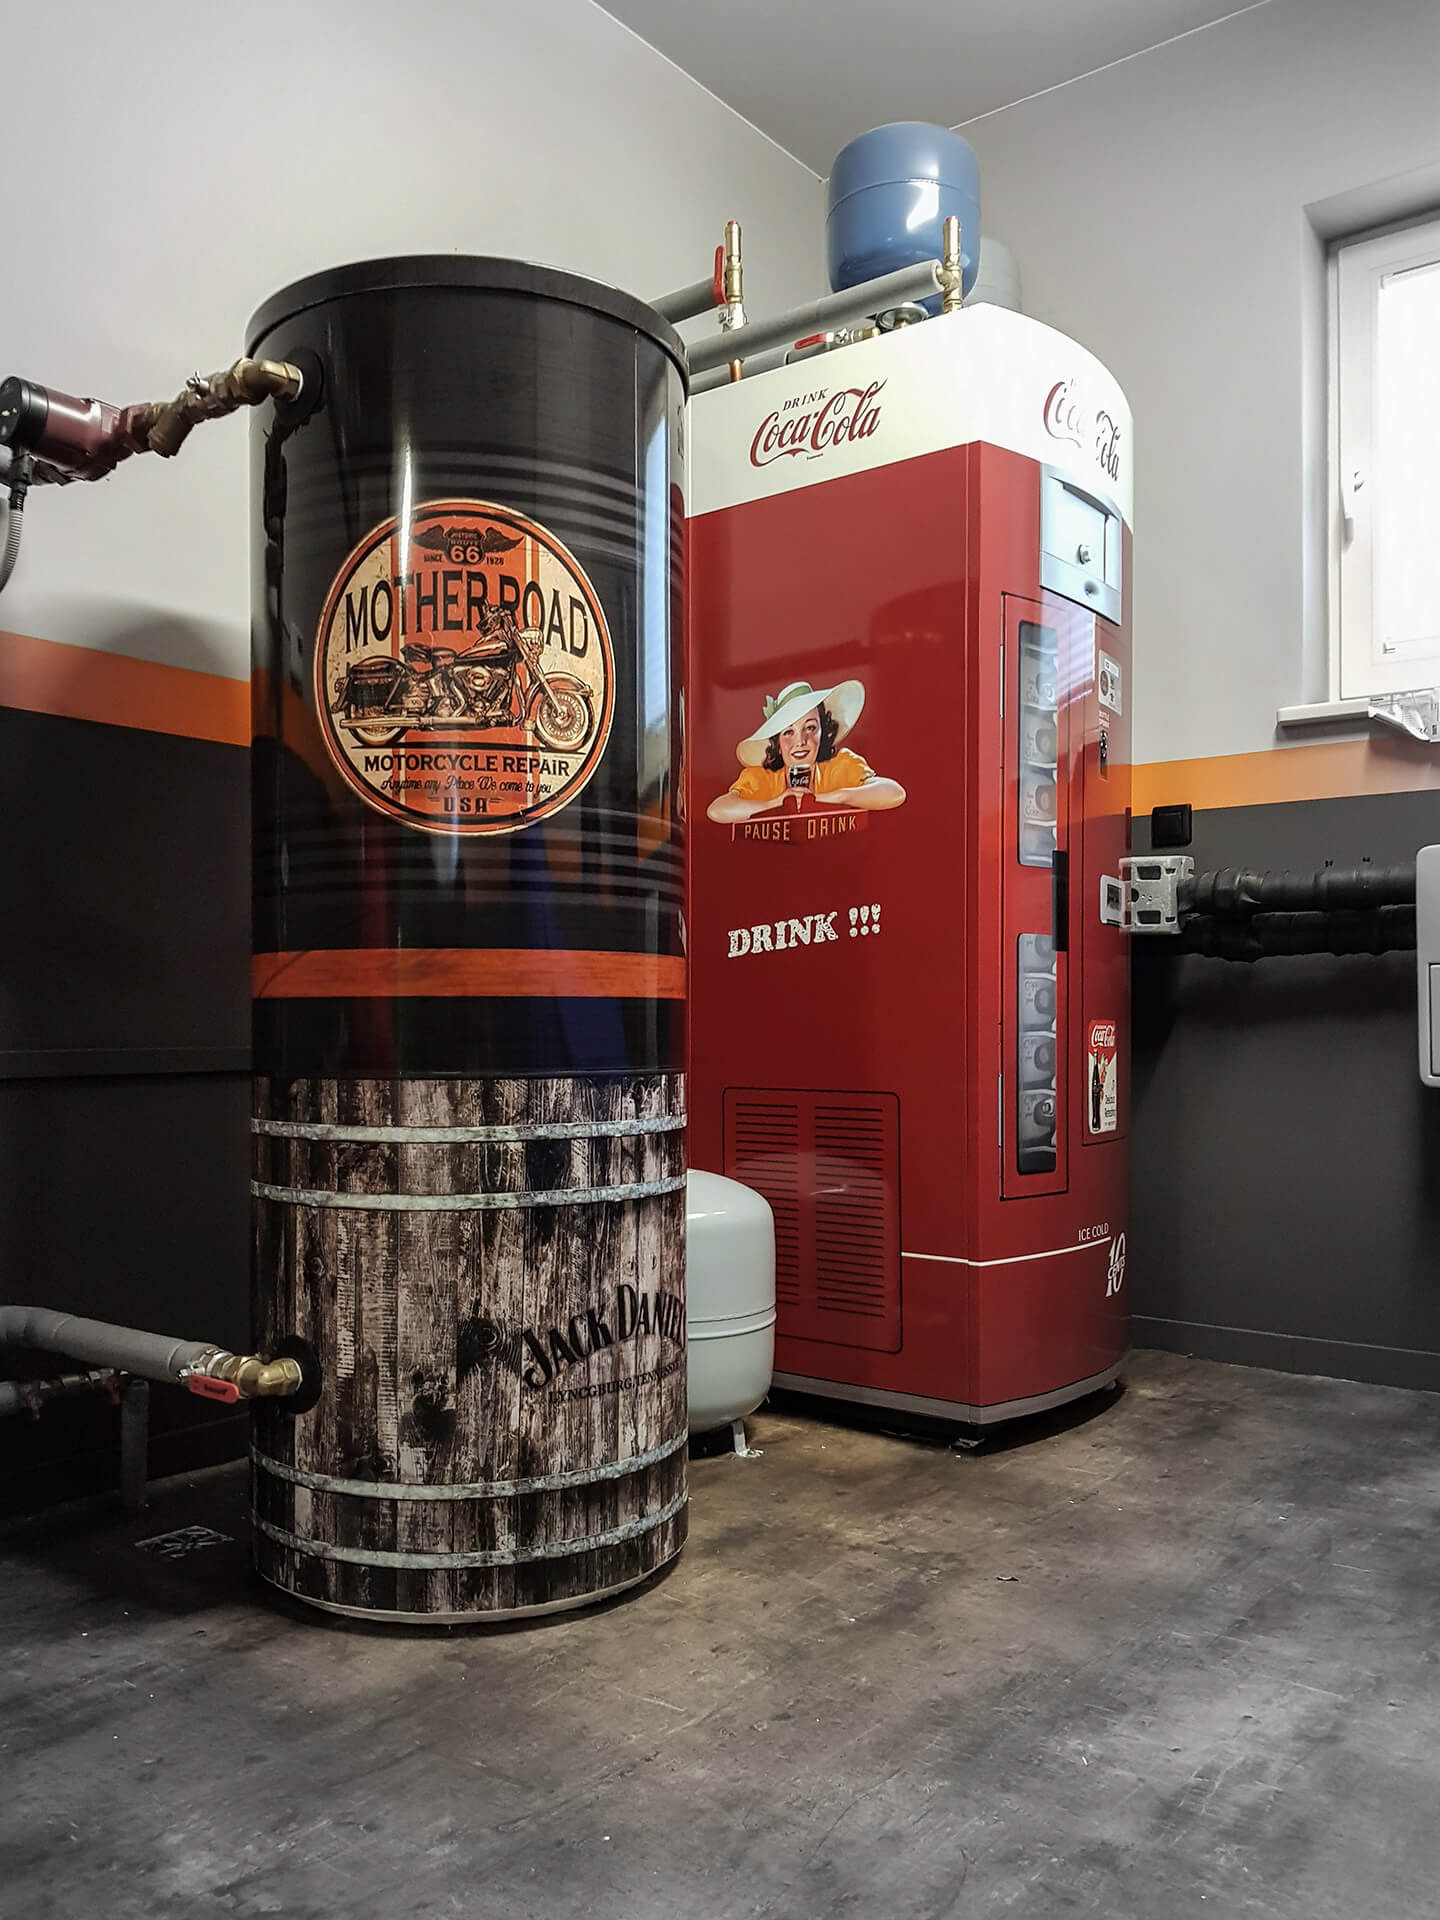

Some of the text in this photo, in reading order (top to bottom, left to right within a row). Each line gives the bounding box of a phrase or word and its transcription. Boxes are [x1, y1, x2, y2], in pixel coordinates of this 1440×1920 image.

[783, 388, 830, 412] DRINK
[750, 377, 888, 467] Coca-Cola
[450, 545, 480, 563] 66
[345, 570, 588, 658] MOTHER ROAD
[365, 755, 498, 772] MOTORCYCLE
[444, 775, 474, 790] Place
[478, 777, 497, 791] We
[500, 781, 523, 791] come
[525, 780, 535, 792] to
[536, 783, 552, 798] you
[444, 797, 488, 813] USA
[744, 815, 857, 841] PAUSE DRINK
[728, 904, 881, 958] DRINK !!!
[1078, 1222, 1109, 1241] ICE COLD
[522, 1304, 614, 1388] JACK
